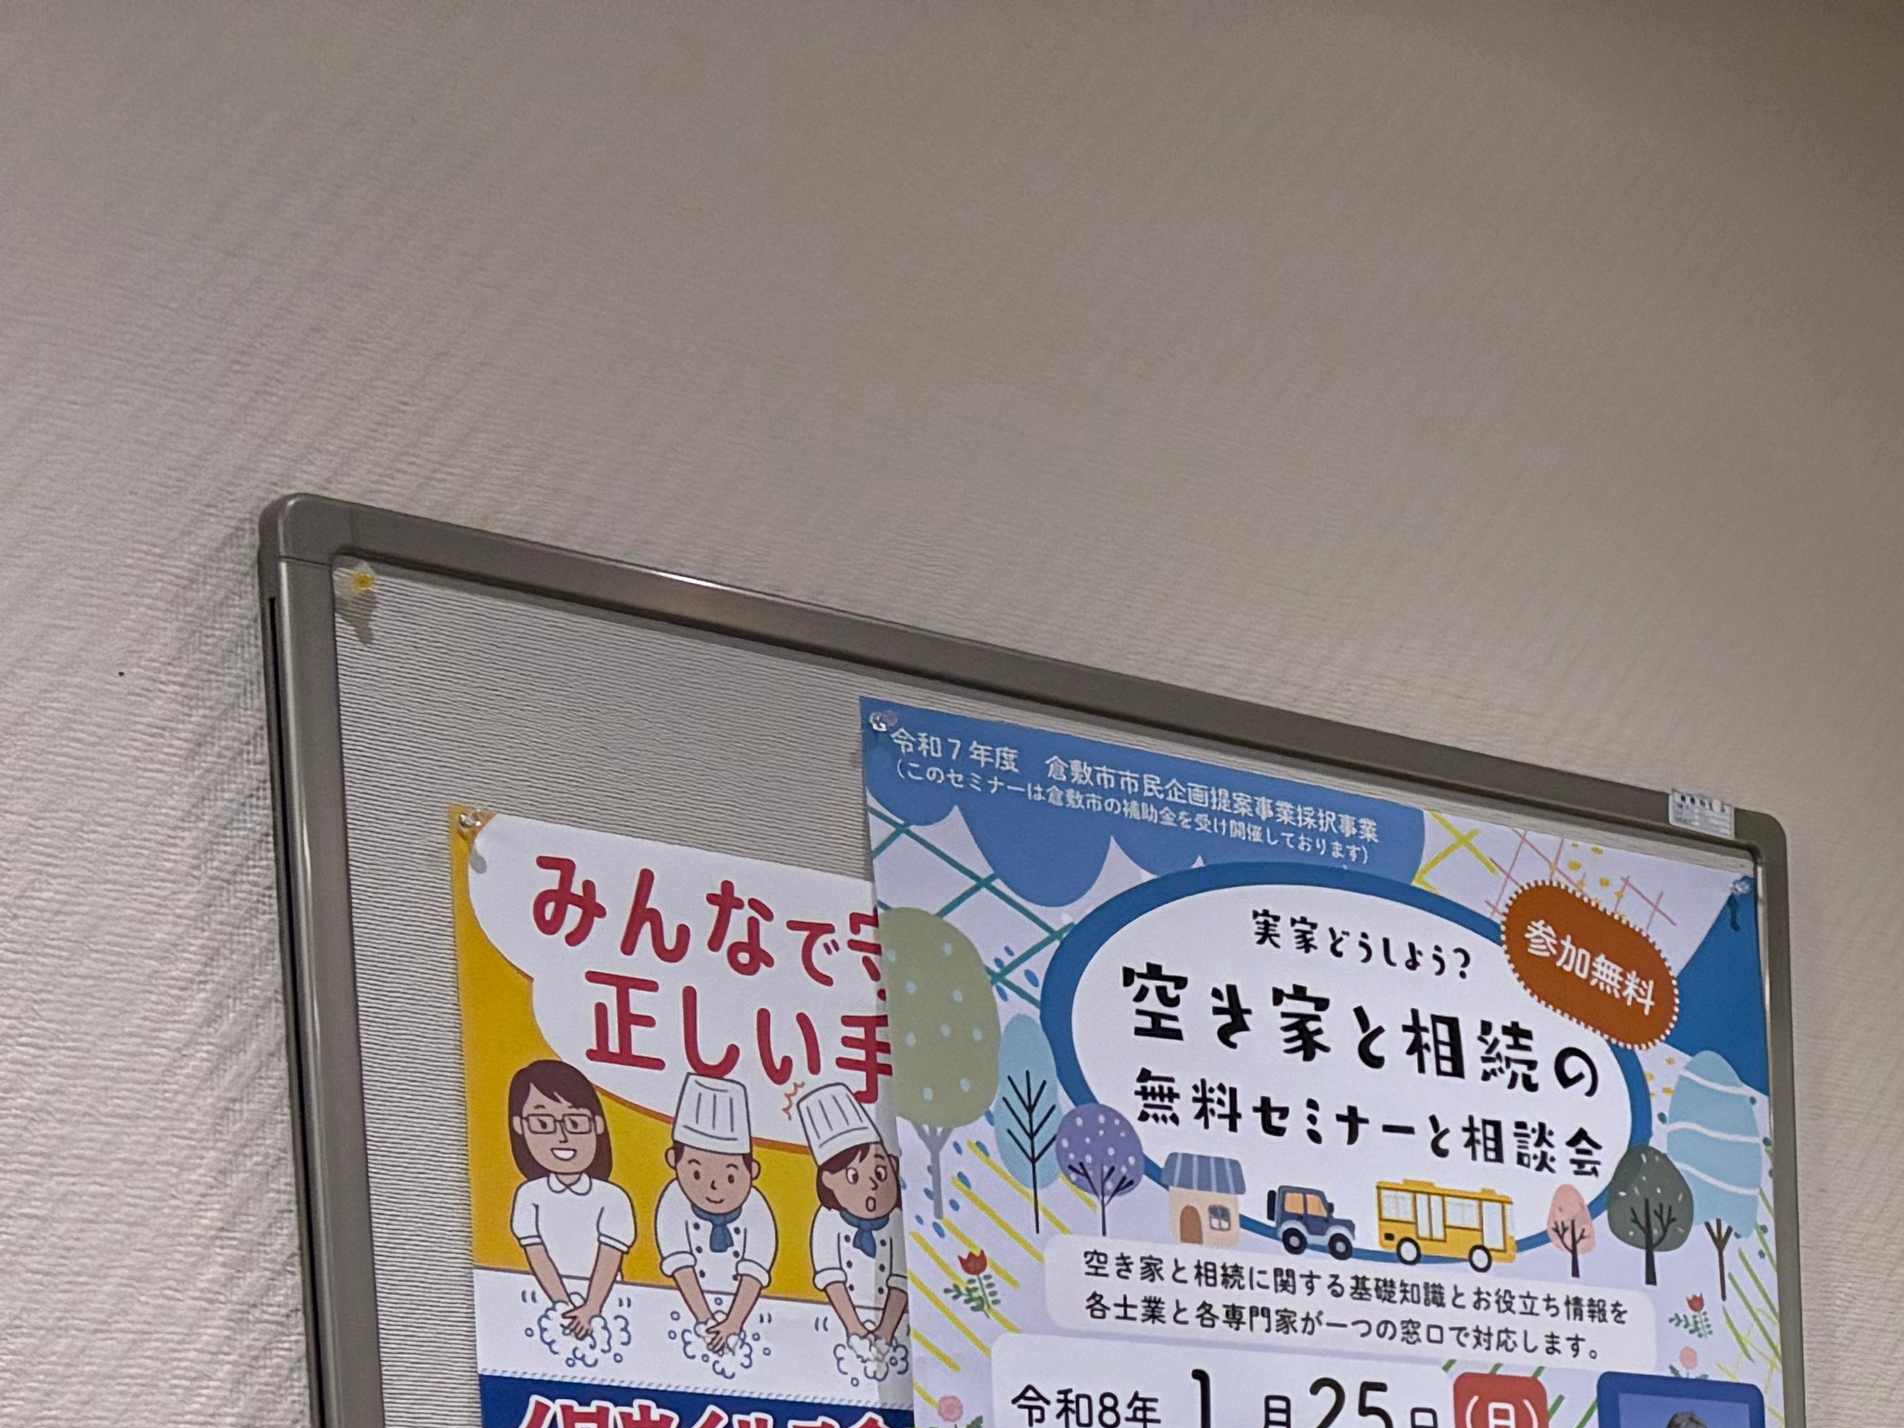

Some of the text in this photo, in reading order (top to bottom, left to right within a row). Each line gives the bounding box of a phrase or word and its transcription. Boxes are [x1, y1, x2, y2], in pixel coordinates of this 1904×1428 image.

[1523, 918, 1656, 1017] 参加無料
[585, 970, 893, 1104] 正しい手
[1121, 961, 1600, 1098] 空き家と相続の
[1133, 1066, 1603, 1179] 無料セミナーと相談会
[1082, 1248, 1629, 1326] 空き家と相続に関する基礎知識とお役立ち情報を
[1084, 1290, 1601, 1361] 各士業と各専門家が一つの窓口で対応します。
